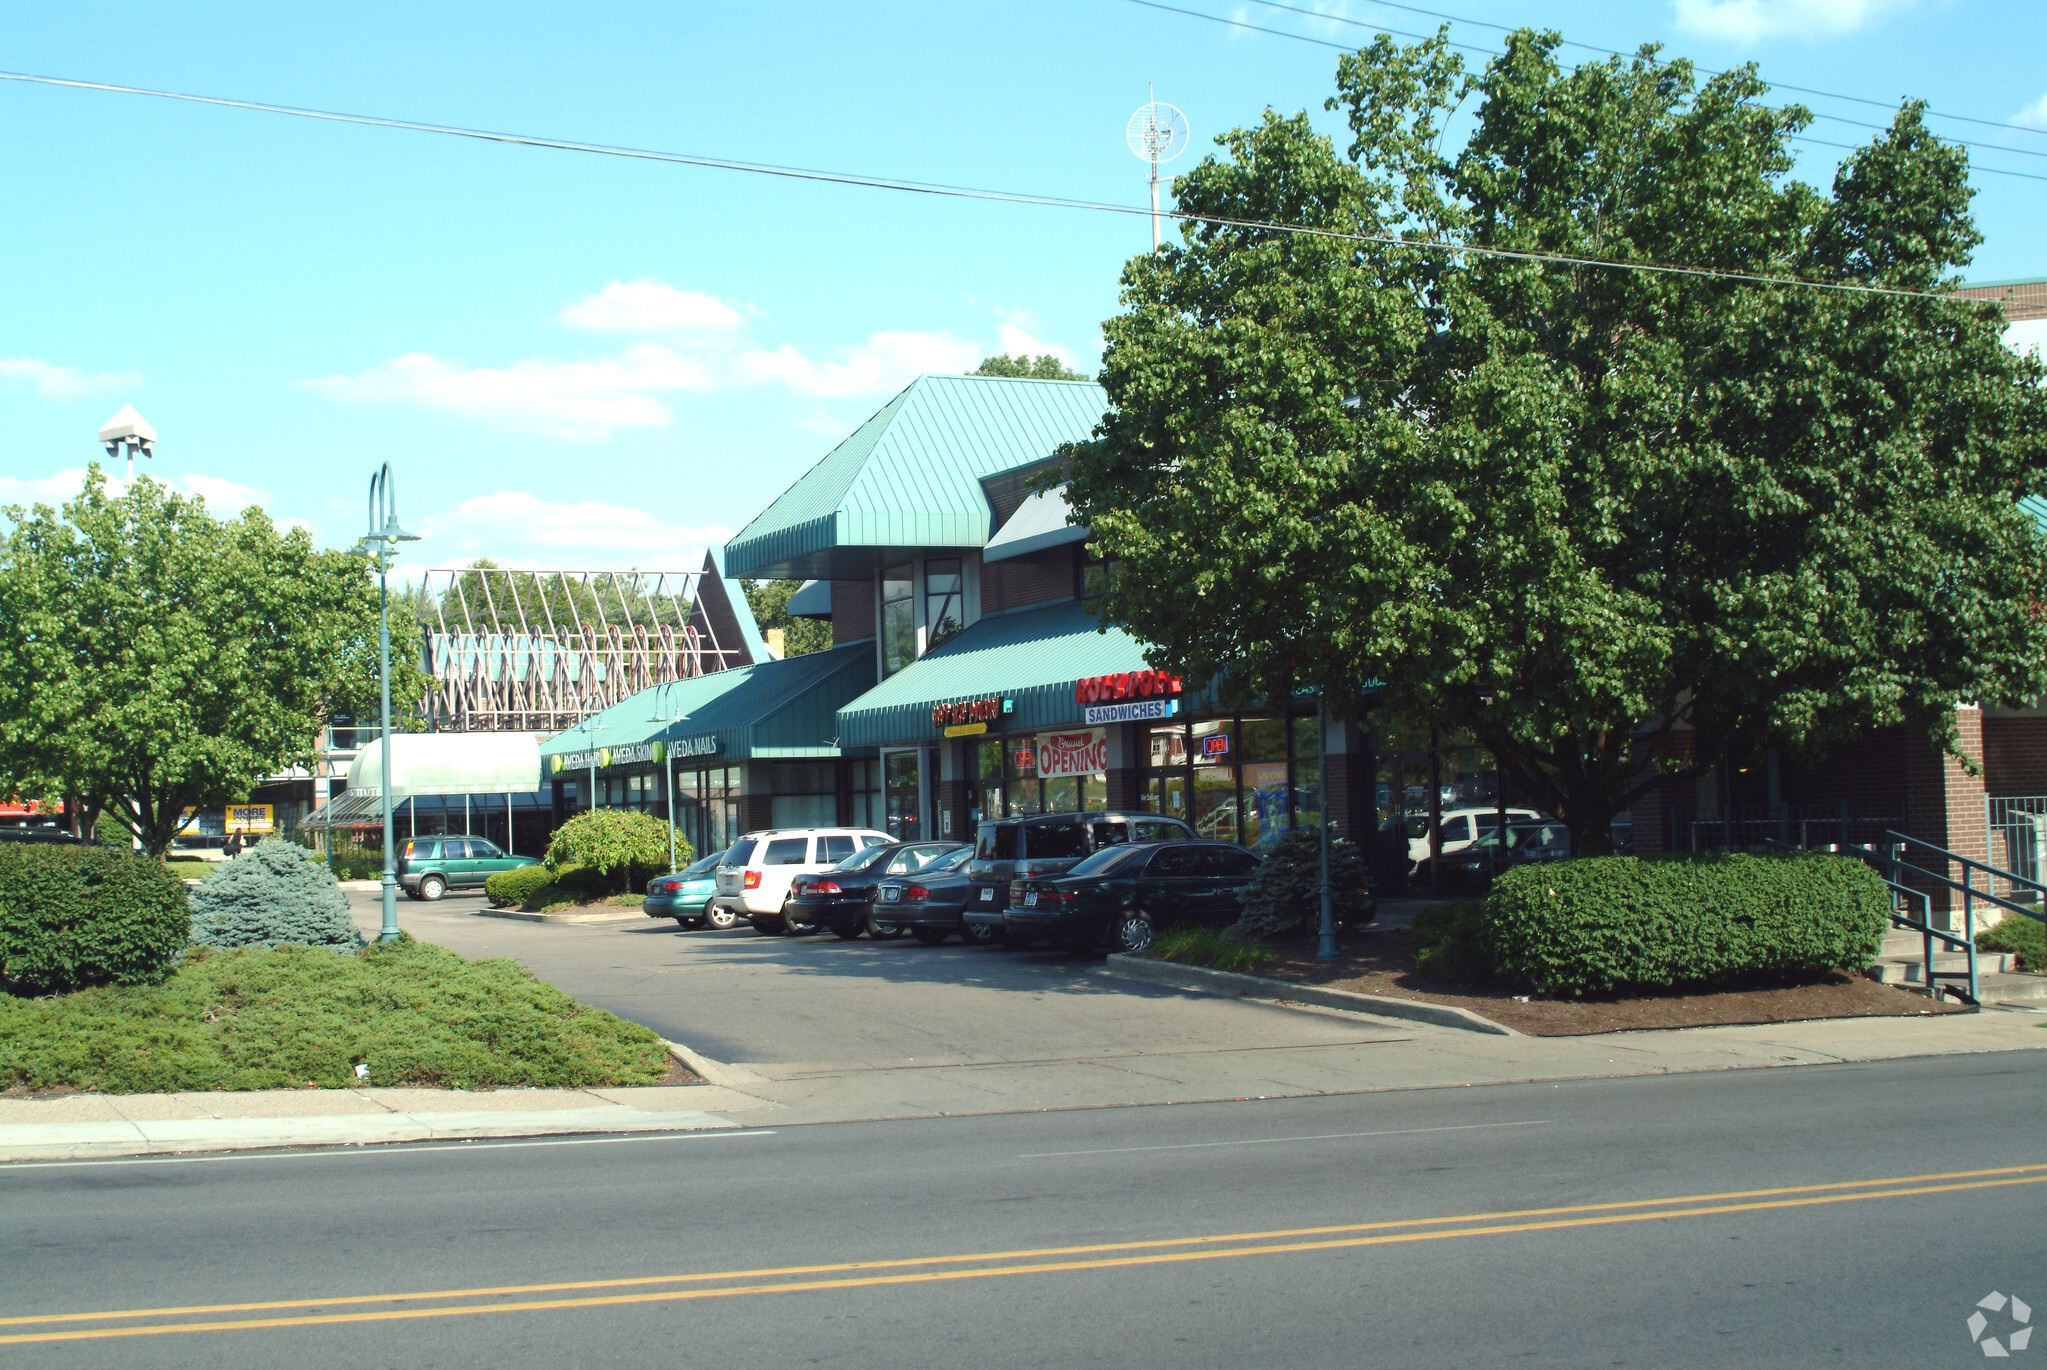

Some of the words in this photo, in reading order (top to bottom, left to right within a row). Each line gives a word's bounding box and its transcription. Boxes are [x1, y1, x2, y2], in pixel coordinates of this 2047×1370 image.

[1075, 672, 1128, 703] ROLY
[1089, 702, 1162, 722] SANDWICHES
[667, 739, 693, 758] AVEDA
[694, 736, 716, 755] NAILS
[1058, 735, 1084, 749] Grand
[1204, 738, 1227, 753] OPEN
[563, 753, 585, 770] AVEDA
[612, 746, 635, 765] AVEDA
[637, 744, 652, 762] SKIN
[1040, 738, 1107, 775] OPENING
[233, 808, 265, 816] MORE
